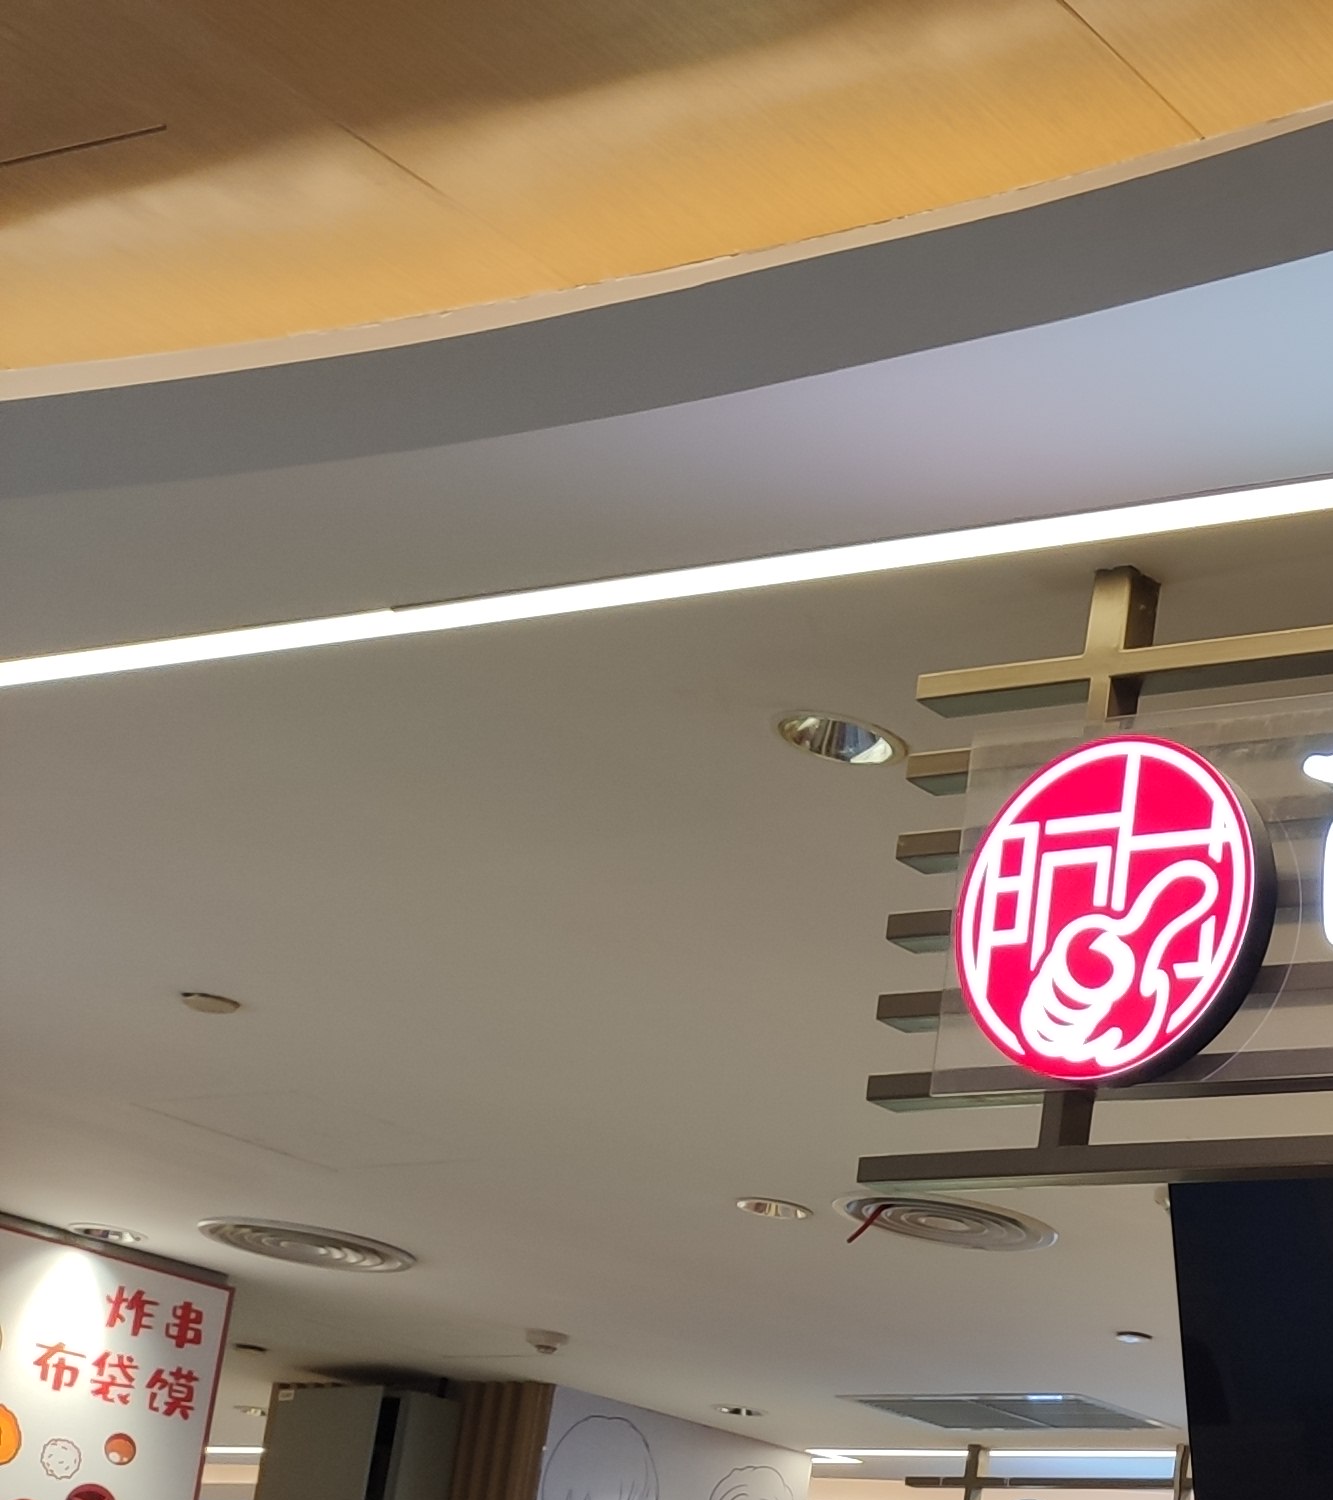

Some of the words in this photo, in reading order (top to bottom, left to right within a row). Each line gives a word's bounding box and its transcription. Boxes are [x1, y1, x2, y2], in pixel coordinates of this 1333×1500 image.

[106, 1284, 204, 1350] 炸串
[32, 1341, 200, 1421] 布袋馍
